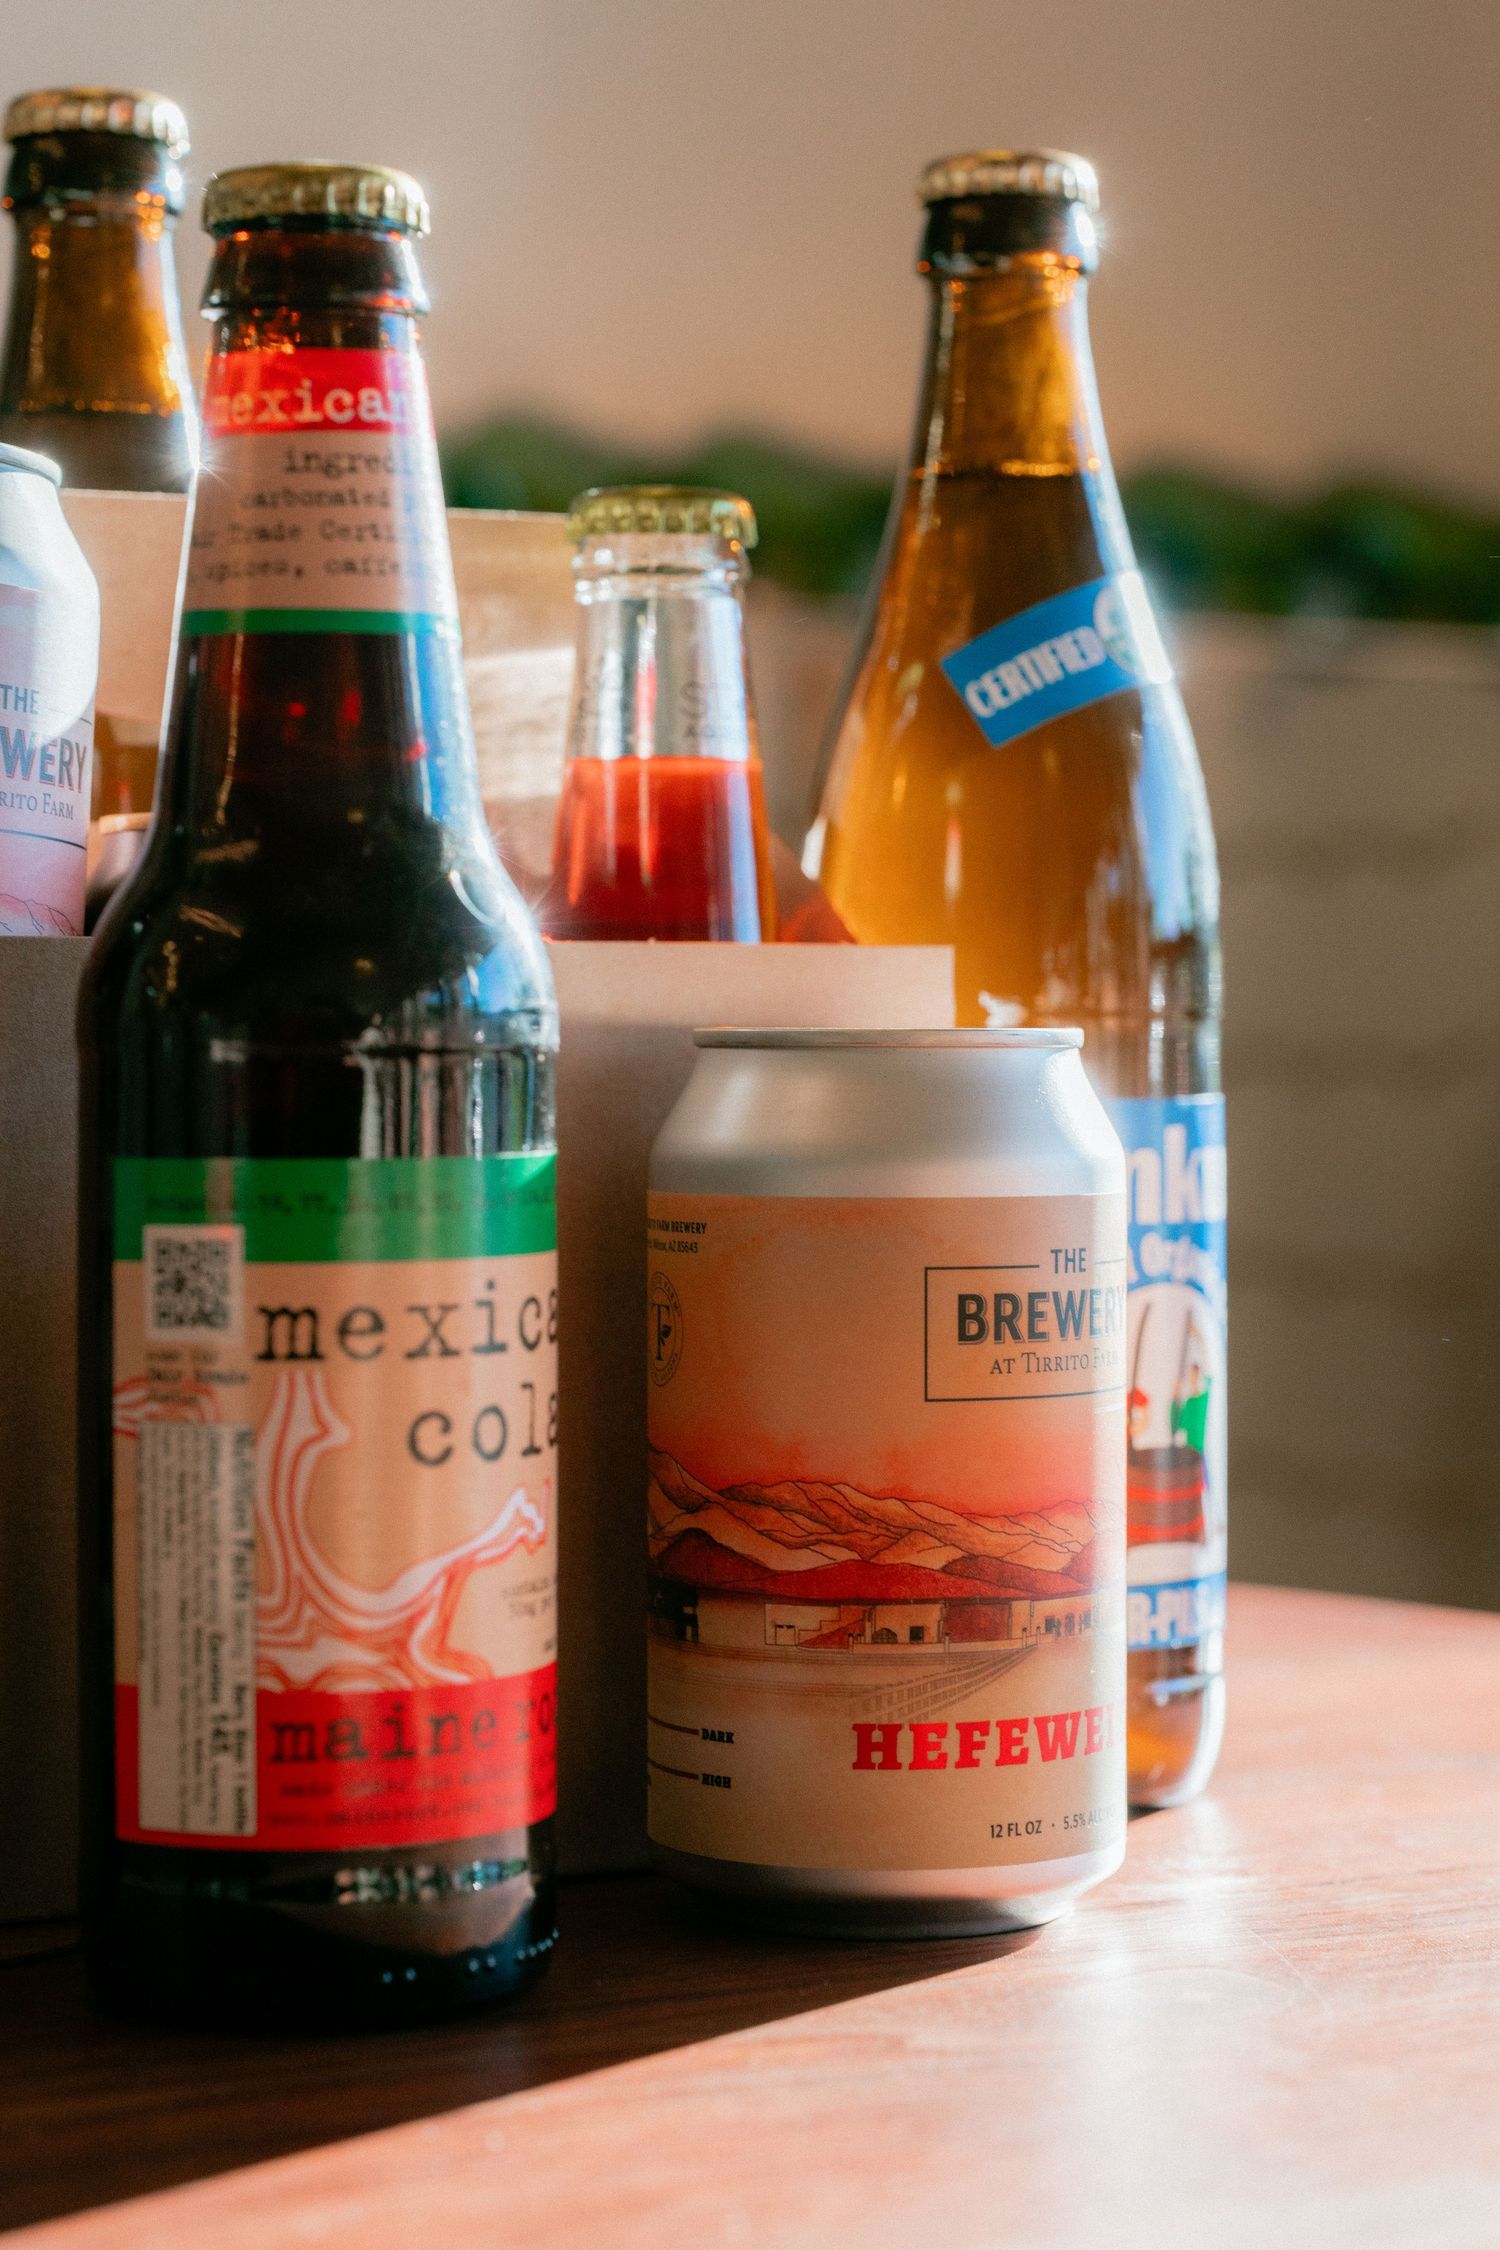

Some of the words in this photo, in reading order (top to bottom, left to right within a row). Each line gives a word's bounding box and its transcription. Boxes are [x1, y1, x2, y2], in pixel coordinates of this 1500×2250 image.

[0, 683, 39, 715] THE
[671, 1219, 707, 1234] BREWERY
[1050, 1248, 1087, 1273] THE
[990, 1358, 1015, 1374] AT
[269, 1701, 497, 1764] maine
[702, 1728, 734, 1744] DARK
[702, 1773, 732, 1788] HIGH
[990, 1824, 1003, 1839] 12
[1007, 1822, 1022, 1836] FL
[1025, 1820, 1042, 1835] OZ
[1063, 1813, 1086, 1830] 5.5%
